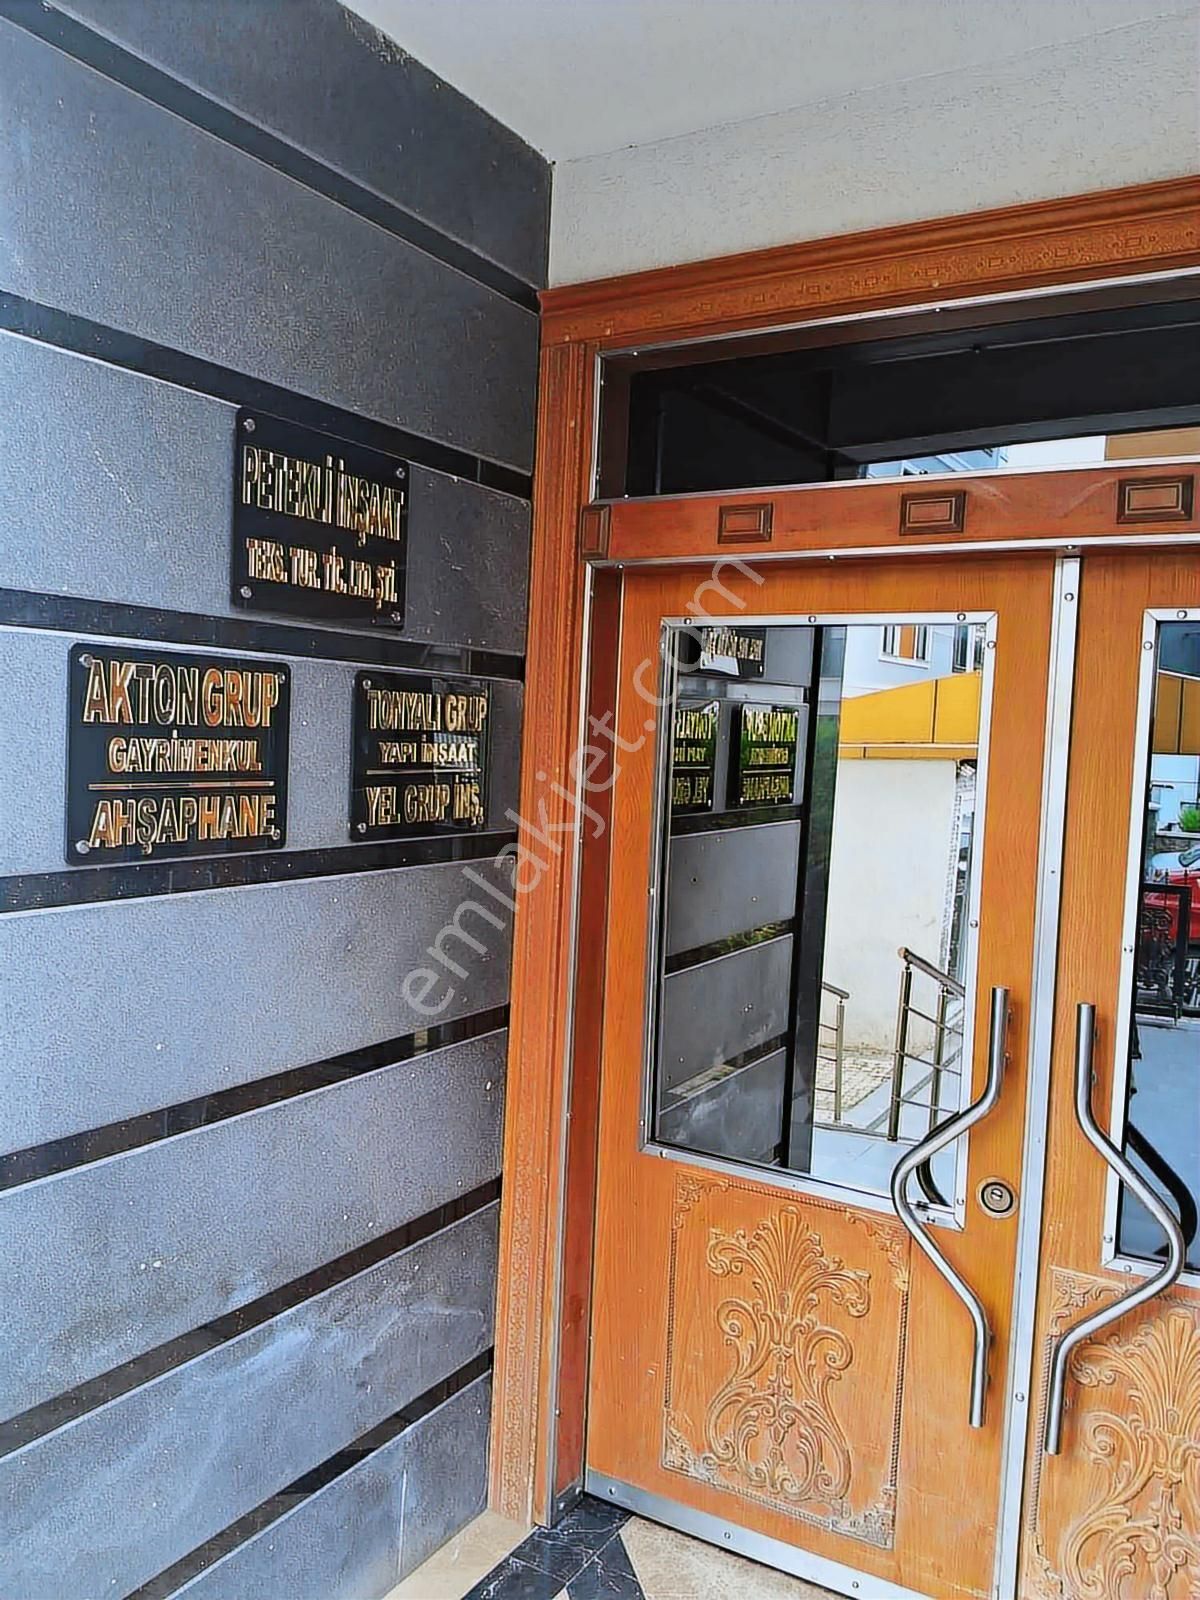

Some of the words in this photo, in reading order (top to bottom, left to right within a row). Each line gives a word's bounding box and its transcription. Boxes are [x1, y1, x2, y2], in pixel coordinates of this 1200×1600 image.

[243, 445, 332, 523] PETEKLİ
[336, 459, 404, 547] İNŞAAT
[246, 537, 288, 583] TEKS.
[289, 546, 321, 589] TUR.
[322, 546, 348, 594] TİC.
[349, 560, 375, 599] LTD.
[83, 659, 200, 725] AKTON
[202, 668, 279, 728] GRUP
[368, 690, 440, 730] TONYALI
[445, 693, 487, 732] GRUP
[108, 729, 262, 773] GAYRİMENKUL
[379, 742, 417, 763] YAPI
[420, 734, 477, 767] İNŞAAT
[89, 795, 276, 855] AHŞAPHANE
[366, 786, 400, 826] YEL
[404, 784, 450, 824] GRUP
